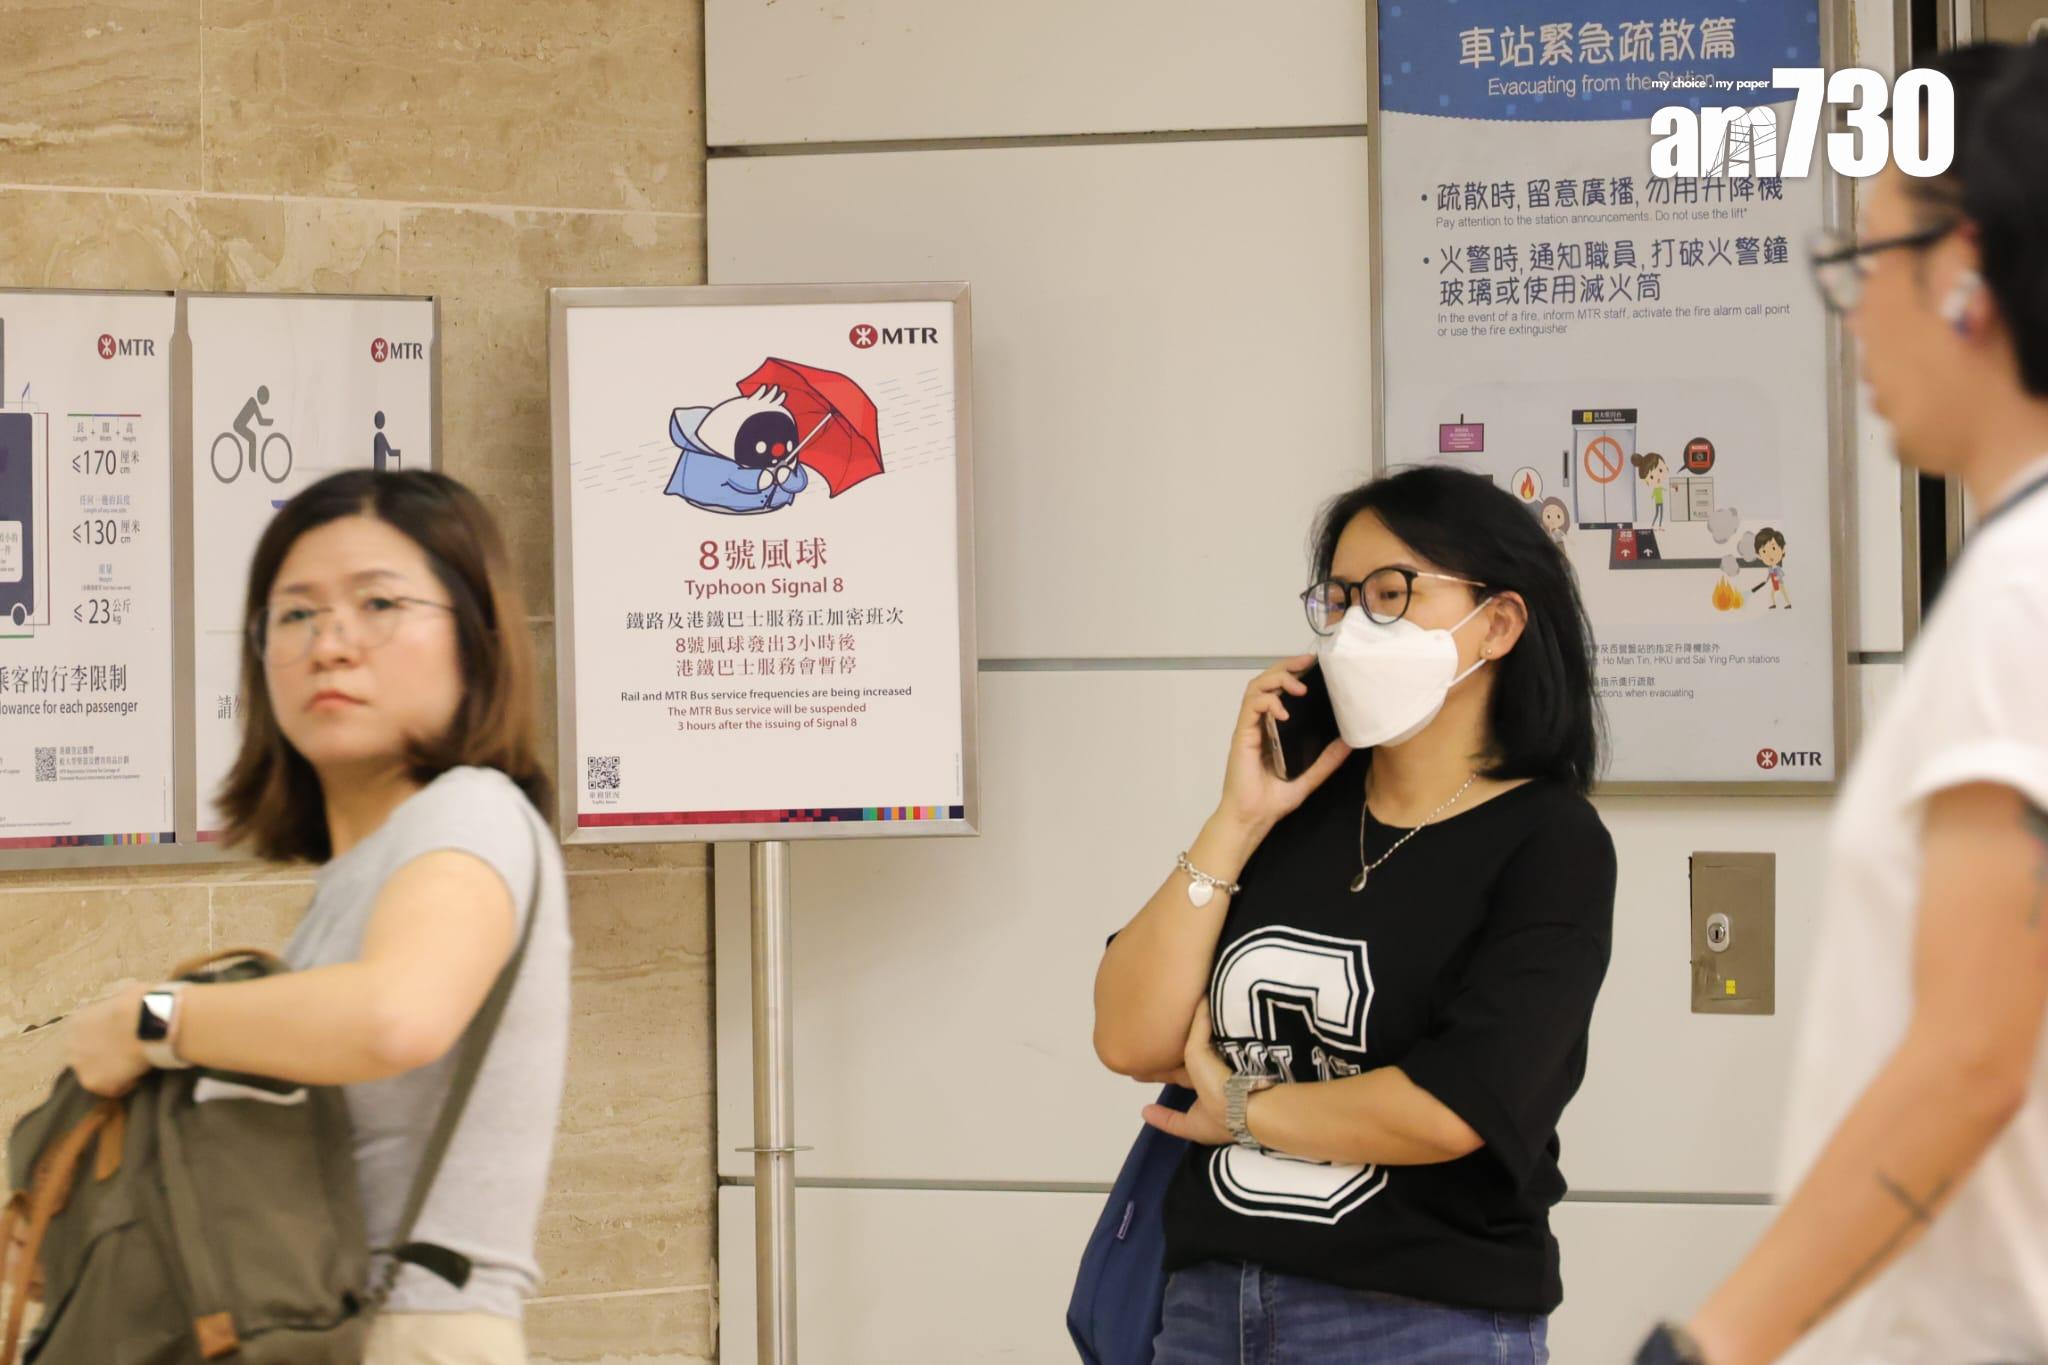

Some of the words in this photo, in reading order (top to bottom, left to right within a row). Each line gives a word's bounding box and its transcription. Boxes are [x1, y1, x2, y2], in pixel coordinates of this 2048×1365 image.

[1459, 17, 1736, 68] 車站緊急疏散篇
[1488, 75, 1576, 97] Evacuating
[1582, 74, 1620, 91] from
[1626, 73, 1651, 90] the
[1436, 217, 1455, 230] Pay
[1458, 215, 1501, 228] attention
[1504, 216, 1514, 226] to
[1517, 215, 1532, 226] the
[1535, 214, 1568, 225] station
[1655, 210, 1670, 221] Do
[1673, 210, 1688, 220] not
[1691, 210, 1709, 220] use
[1712, 208, 1728, 219] the
[1439, 273, 1661, 307] 玻璃或使用滅火筒
[1437, 313, 1447, 323] In
[1450, 313, 1465, 323] the
[1468, 312, 1496, 322] event
[1498, 312, 1509, 322] of
[1512, 313, 1518, 321] a
[1543, 310, 1574, 321] inform
[1577, 309, 1601, 320] MTR
[1632, 307, 1672, 319] activate
[1675, 307, 1691, 317] the
[1694, 306, 1711, 317] fire
[1713, 305, 1742, 316] alarm
[1745, 304, 1762, 315] call
[1765, 303, 1791, 317] point
[882, 327, 939, 345] MTR
[1437, 328, 1448, 337] or
[1451, 327, 1468, 337] use
[1471, 326, 1487, 336] the
[1489, 324, 1506, 335] fire
[1509, 323, 1567, 337] extinguisher
[118, 338, 155, 356] MTR
[390, 342, 423, 360] MTR
[699, 538, 828, 570] 8號風球
[684, 579, 766, 599] Typhoon
[771, 577, 828, 598] Signal
[833, 577, 844, 593] 8
[626, 607, 904, 630] 鐵路及港鐵巴士服務正加密班次
[675, 634, 856, 654] 8號風球發出3小時後
[676, 656, 857, 678] 港鐵巴士服務會暫停
[1617, 656, 1635, 665] Man
[1654, 656, 1673, 665] HKU
[1675, 655, 1691, 665] and
[1693, 655, 1706, 665] Sai
[1709, 655, 1727, 667] Ying
[1729, 654, 1746, 664] Pun
[1748, 654, 1781, 664] stations
[621, 692, 640, 702] Rail
[643, 691, 662, 702] and
[665, 691, 688, 701] MTR
[690, 691, 709, 701] Bus
[711, 690, 747, 700] service
[749, 689, 810, 703] frequencies
[812, 689, 829, 698] are
[831, 688, 861, 701] being
[863, 685, 912, 697] increased
[1625, 687, 1647, 698] when
[1650, 687, 1694, 700] evacuating
[43, 699, 58, 715] for
[60, 700, 84, 715] each
[86, 699, 138, 717] passenger
[668, 706, 688, 717] The
[690, 706, 713, 717] MTR
[715, 706, 734, 716] Bus
[736, 705, 772, 716] service
[774, 704, 792, 715] will
[795, 703, 807, 714] be
[809, 703, 867, 717] suspended
[677, 721, 684, 731] 3
[687, 720, 716, 731] hours
[719, 719, 743, 730] after
[746, 719, 763, 729] the
[765, 718, 801, 731] issuing
[804, 718, 815, 728] of
[817, 717, 849, 731] Signal
[850, 717, 858, 727] 8
[1780, 750, 1823, 767] MTR
